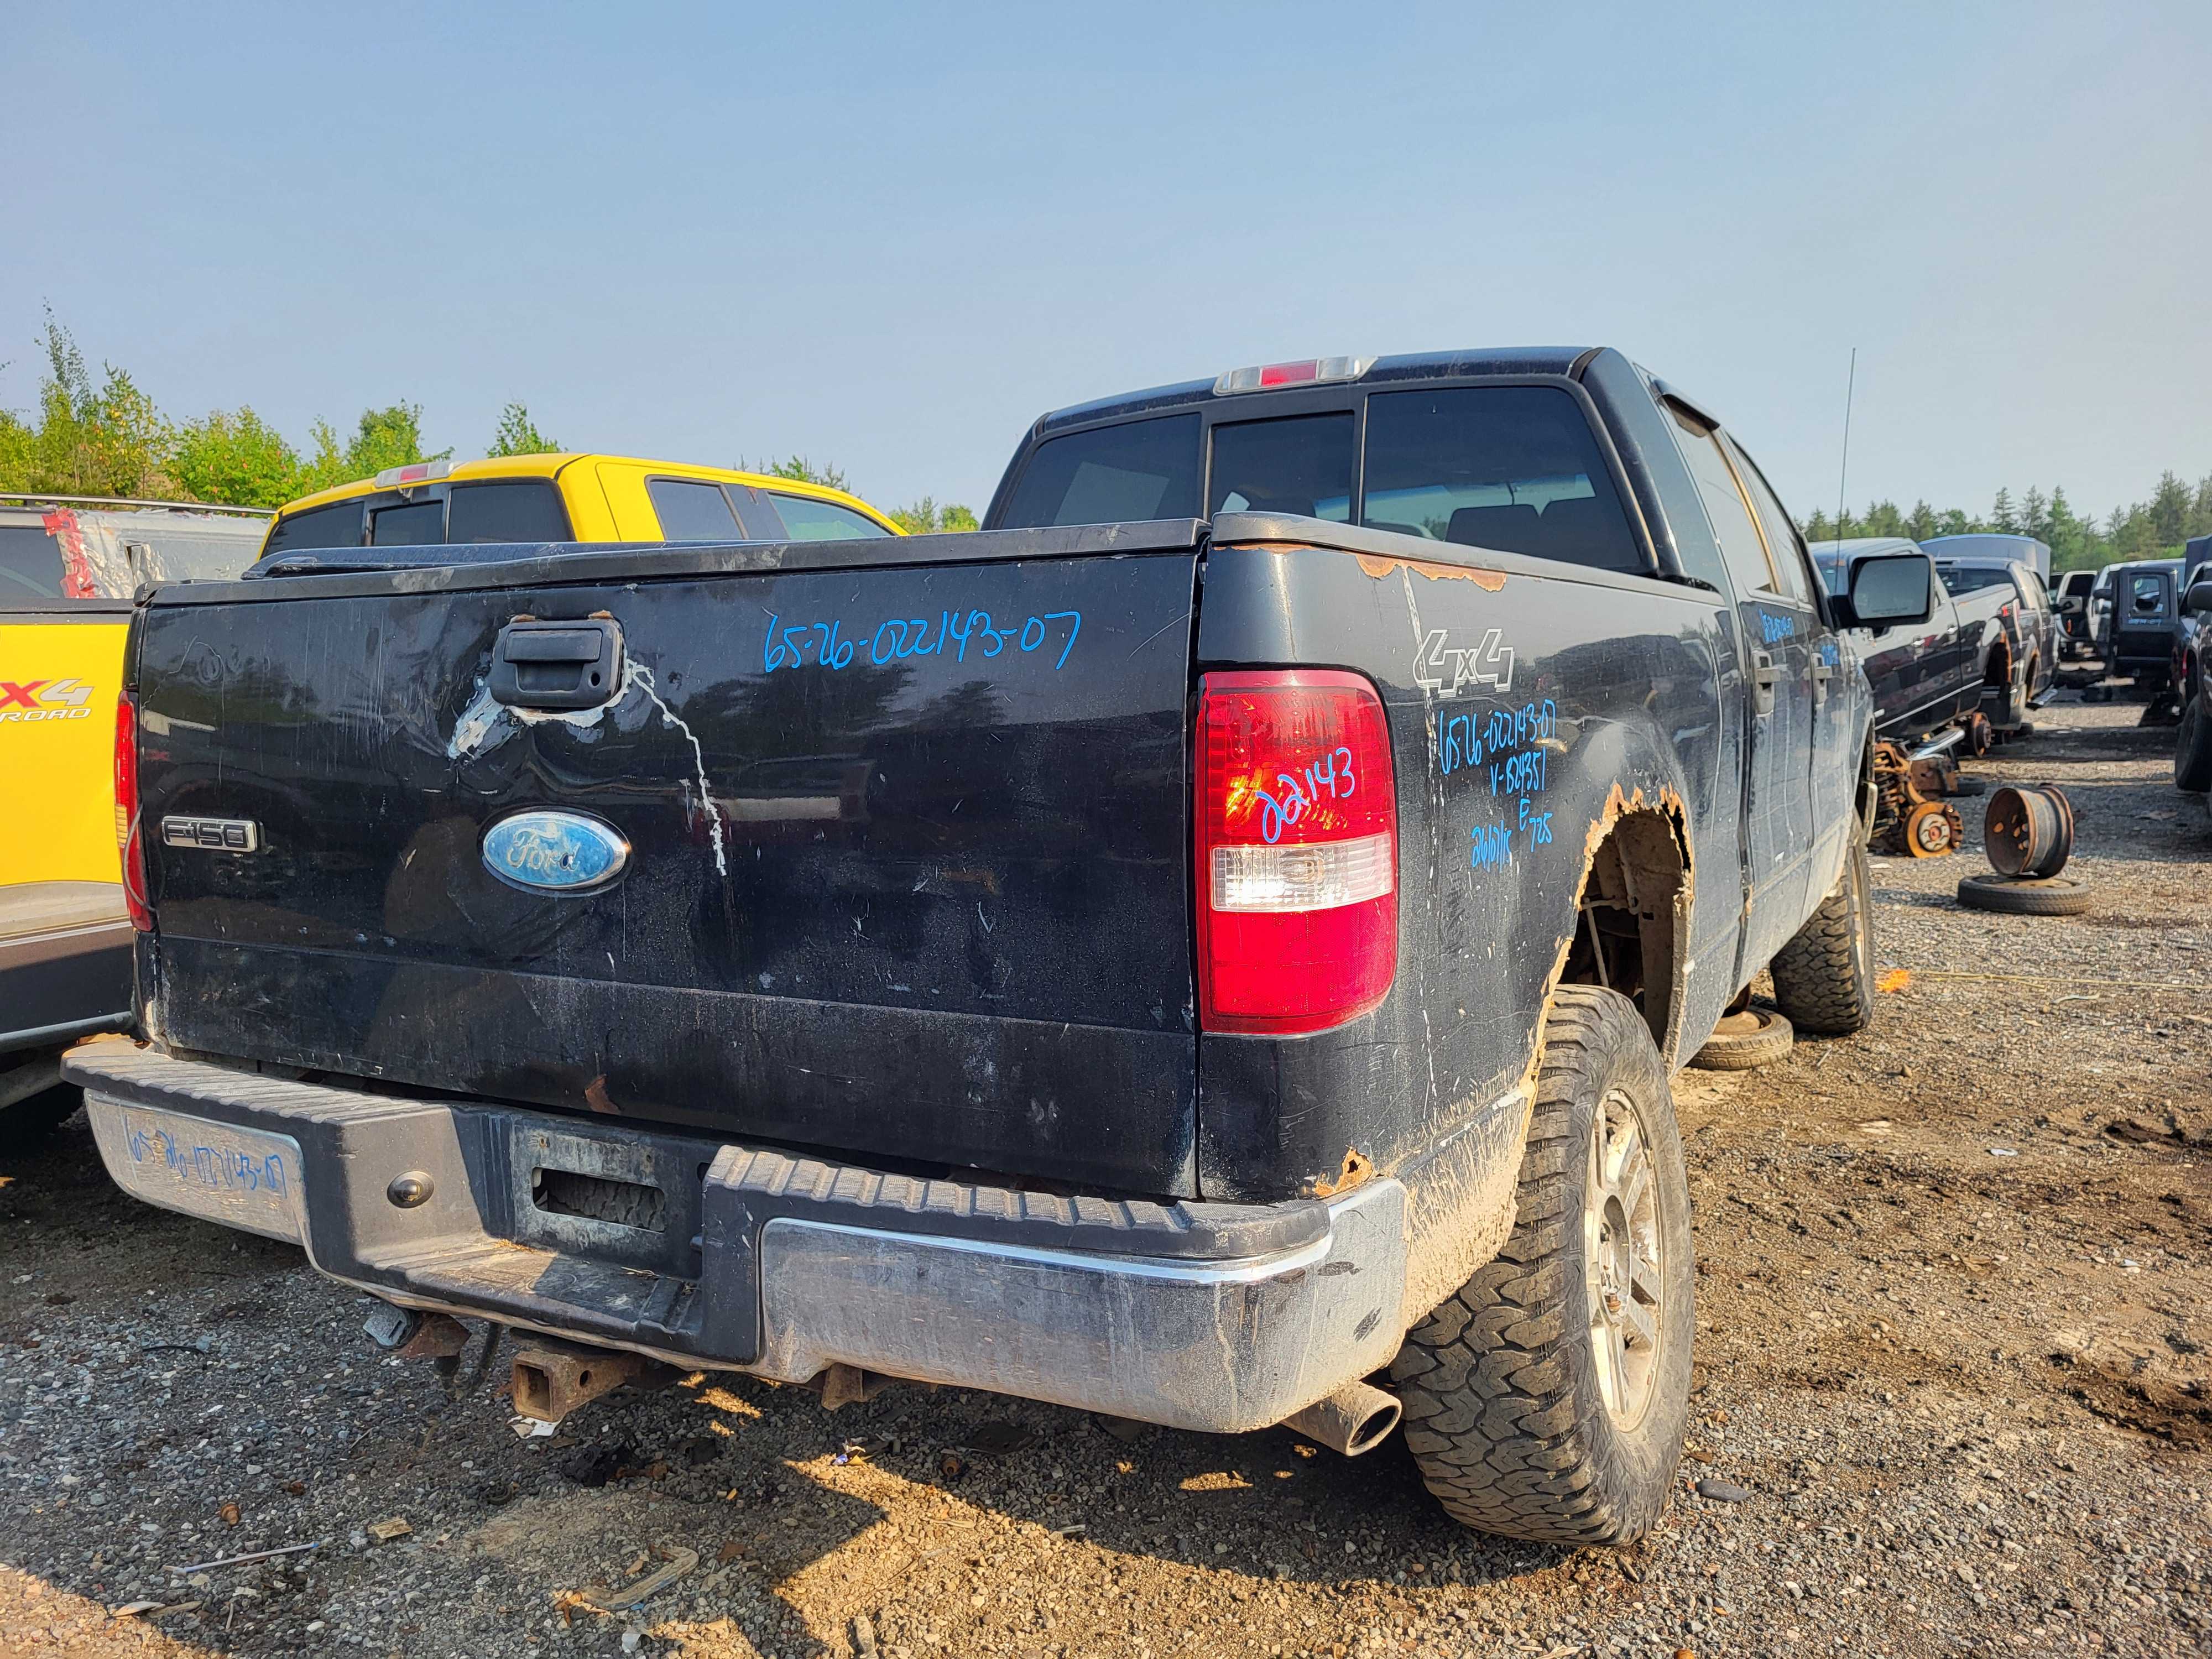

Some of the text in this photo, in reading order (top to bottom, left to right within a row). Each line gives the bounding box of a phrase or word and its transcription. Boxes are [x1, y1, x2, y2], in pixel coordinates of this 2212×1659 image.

[764, 609, 1081, 672] 65-26-022143-07
[0, 708, 92, 722] ROAD
[1255, 747, 1355, 843] 22143
[507, 824, 581, 872] Ford
